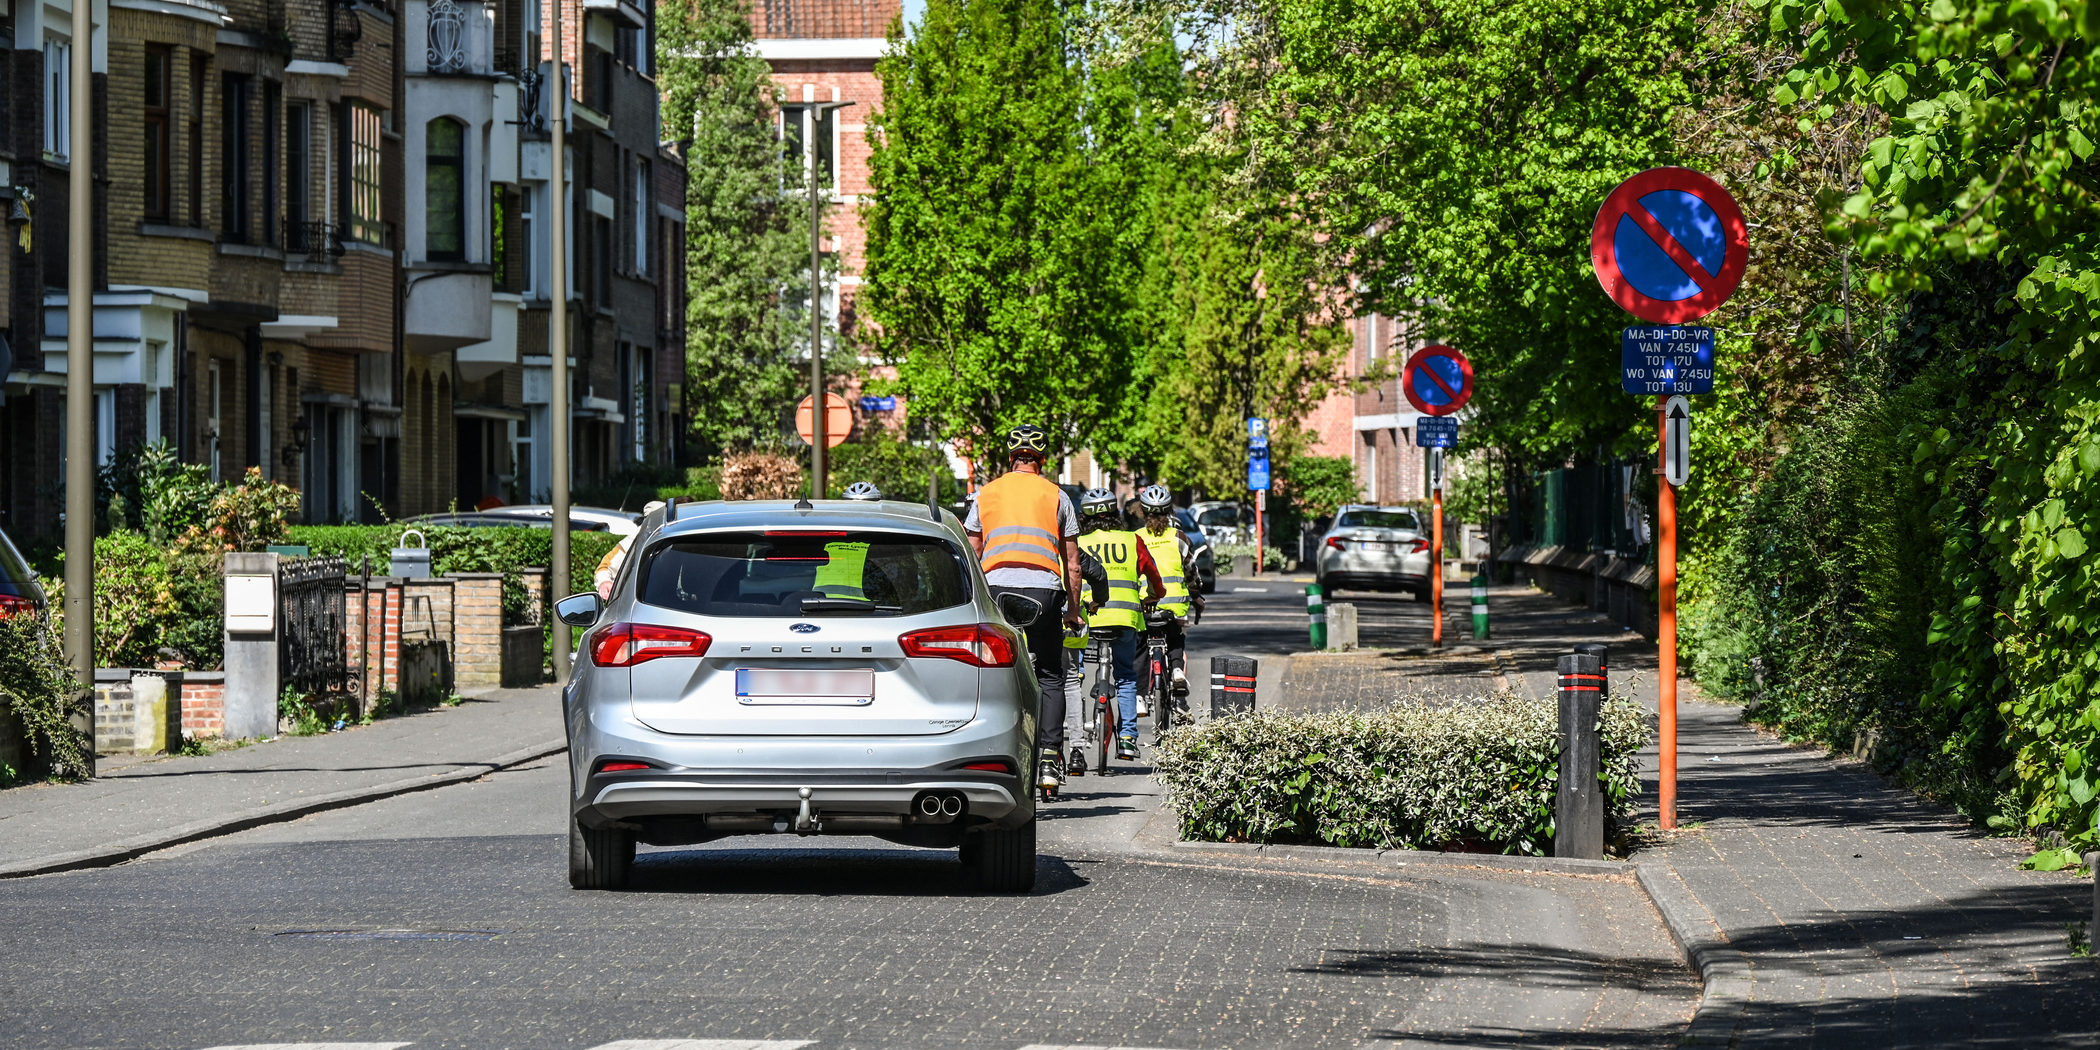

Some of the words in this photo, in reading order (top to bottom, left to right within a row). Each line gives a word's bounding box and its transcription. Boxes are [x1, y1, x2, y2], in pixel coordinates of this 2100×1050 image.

[1628, 329, 1709, 340] MA-DI-DO-VR
[1639, 342, 1661, 353] VAN
[1667, 342, 1700, 353] 7.45U
[1645, 355, 1667, 366] TOT
[1673, 355, 1692, 366] 17U
[1626, 368, 1645, 379] WO
[1652, 368, 1674, 379] VAN
[1680, 368, 1712, 380] 7.45U
[1645, 381, 1667, 392] TOT
[1673, 381, 1692, 393] 13U
[740, 645, 873, 653] FOCUS
